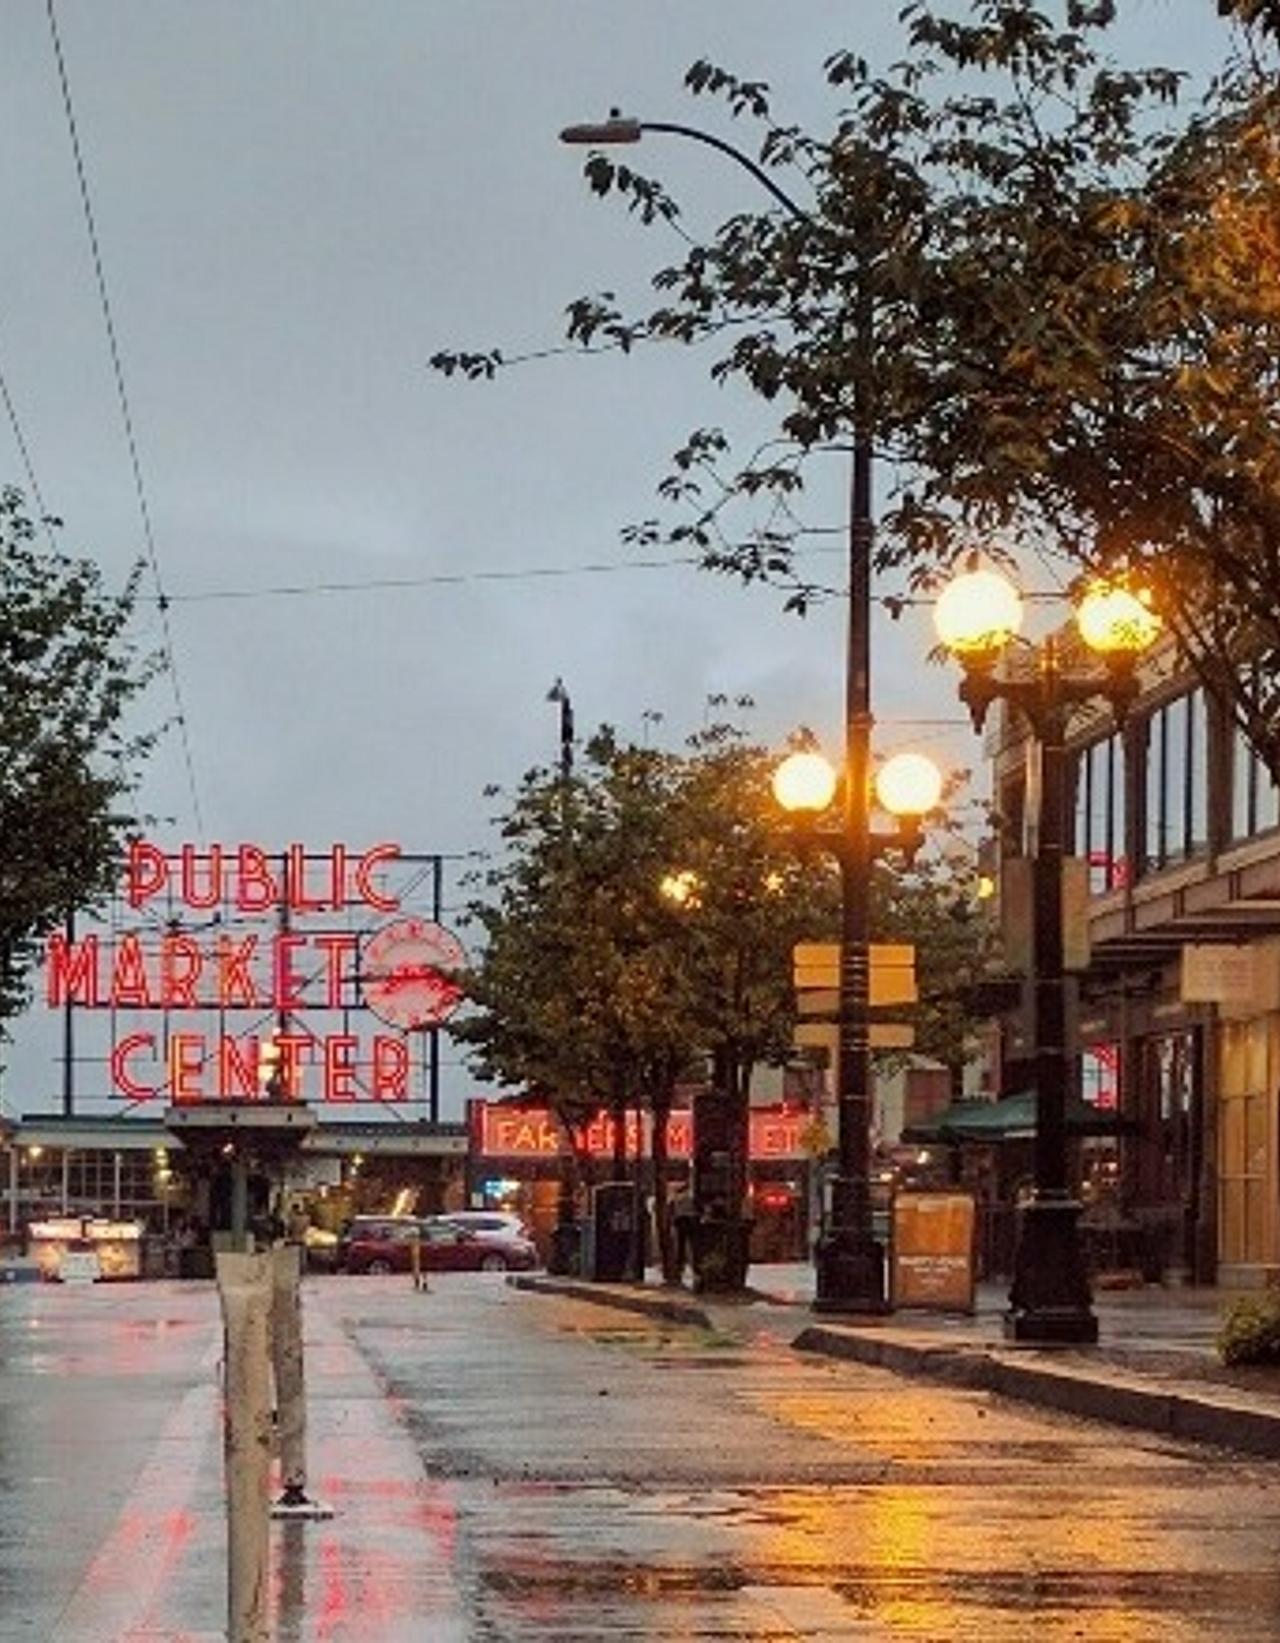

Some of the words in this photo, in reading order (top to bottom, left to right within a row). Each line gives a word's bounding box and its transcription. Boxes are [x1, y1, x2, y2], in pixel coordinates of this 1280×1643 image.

[128, 841, 401, 911] PUBLIC
[47, 932, 359, 1009] MARKET
[110, 1032, 409, 1104] CENTER
[496, 1119, 639, 1152] FARERS
